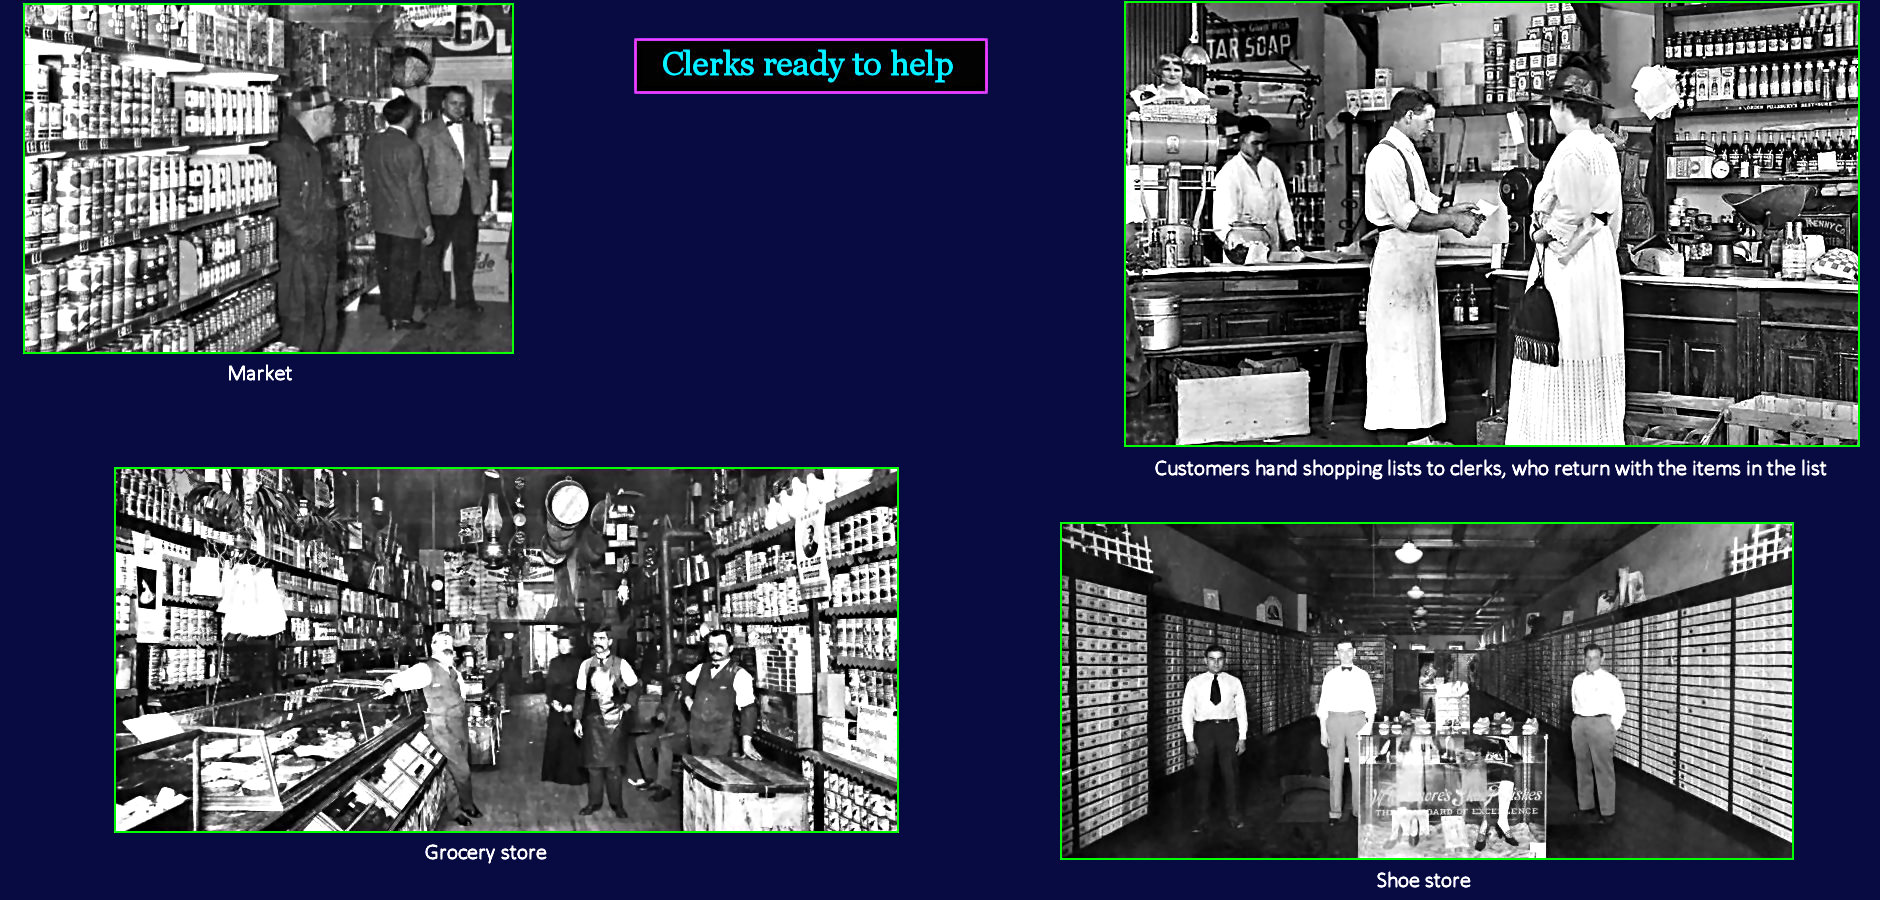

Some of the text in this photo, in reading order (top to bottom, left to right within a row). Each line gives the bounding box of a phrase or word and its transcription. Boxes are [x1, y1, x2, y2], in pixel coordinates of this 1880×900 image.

[448, 16, 490, 45] GA
[1206, 34, 1291, 59] TAR SOAP
[1472, 807, 1539, 815] EXCEENCE
